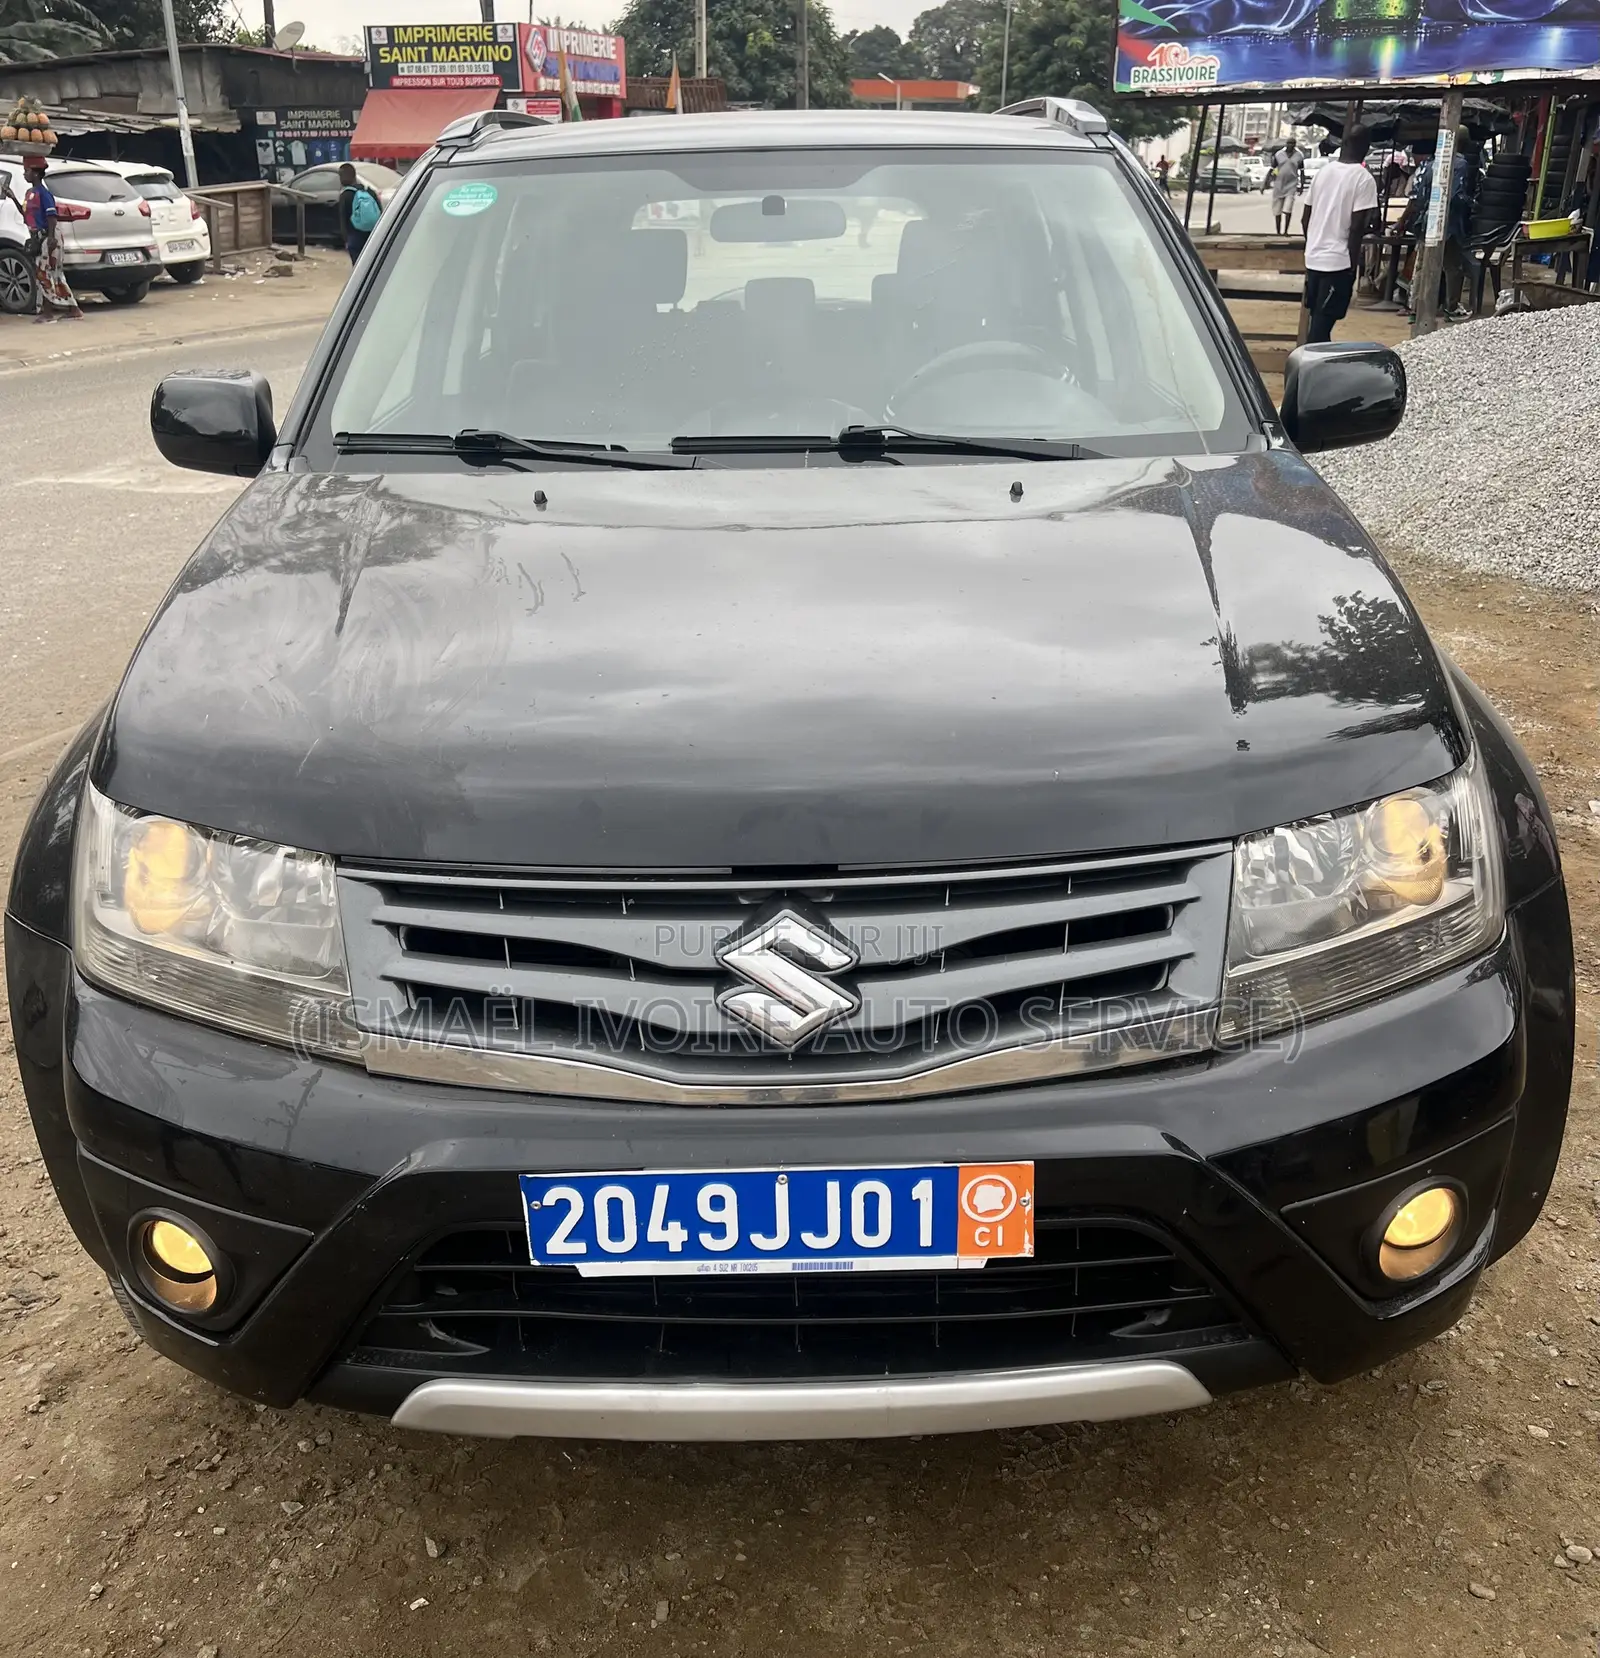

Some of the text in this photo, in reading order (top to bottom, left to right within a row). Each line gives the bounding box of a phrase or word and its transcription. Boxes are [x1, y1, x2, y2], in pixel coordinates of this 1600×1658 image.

[393, 26, 494, 44] IMPRIMERIE
[379, 44, 513, 63] SAINT MARVINO
[392, 76, 500, 87] IMPRESSION SUR TOUS SUPPORTS
[1132, 66, 1216, 84] BRASSIVOIRE
[287, 110, 341, 119] IMPRIMERIE
[280, 120, 351, 130] SAINT MARVINO
[541, 1177, 934, 1255] 2049JJ01
[974, 1225, 1004, 1248] CI
